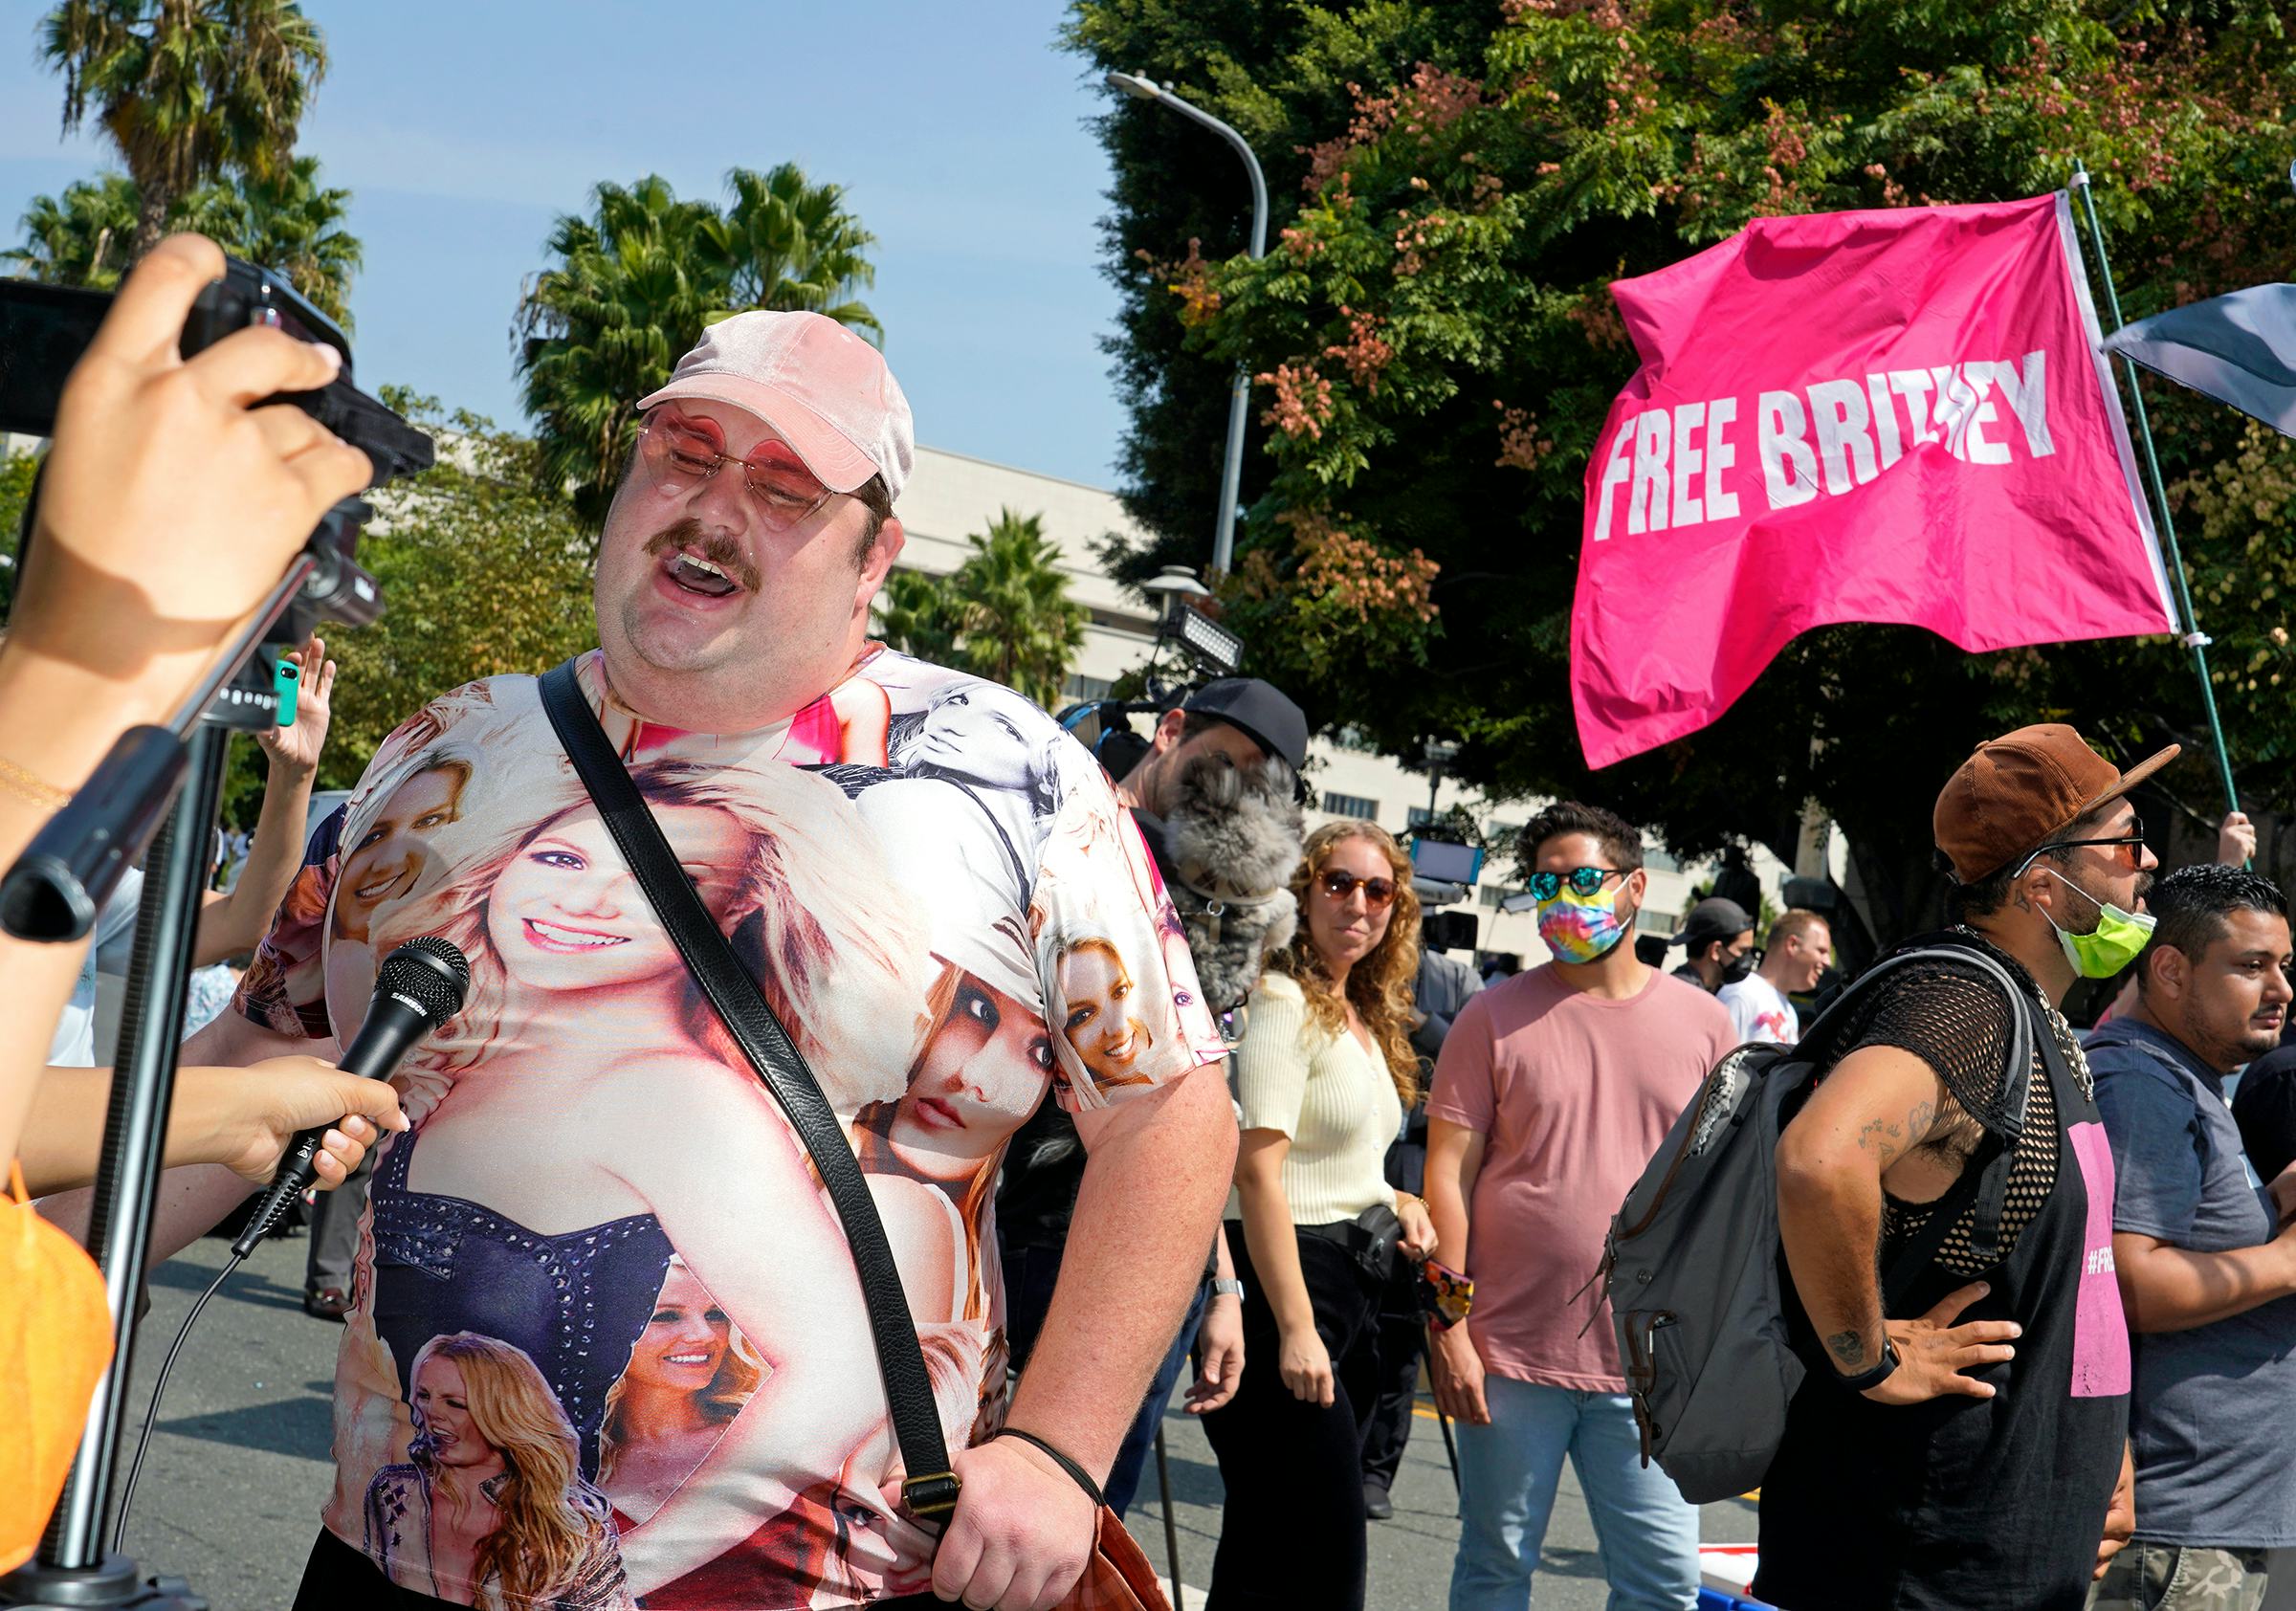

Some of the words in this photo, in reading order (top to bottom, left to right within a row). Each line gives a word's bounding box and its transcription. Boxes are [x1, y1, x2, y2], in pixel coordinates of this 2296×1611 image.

[1595, 398, 1740, 541] FREE
[1758, 350, 2055, 510] BRITNEY
[390, 992, 428, 1017] SAMSON
